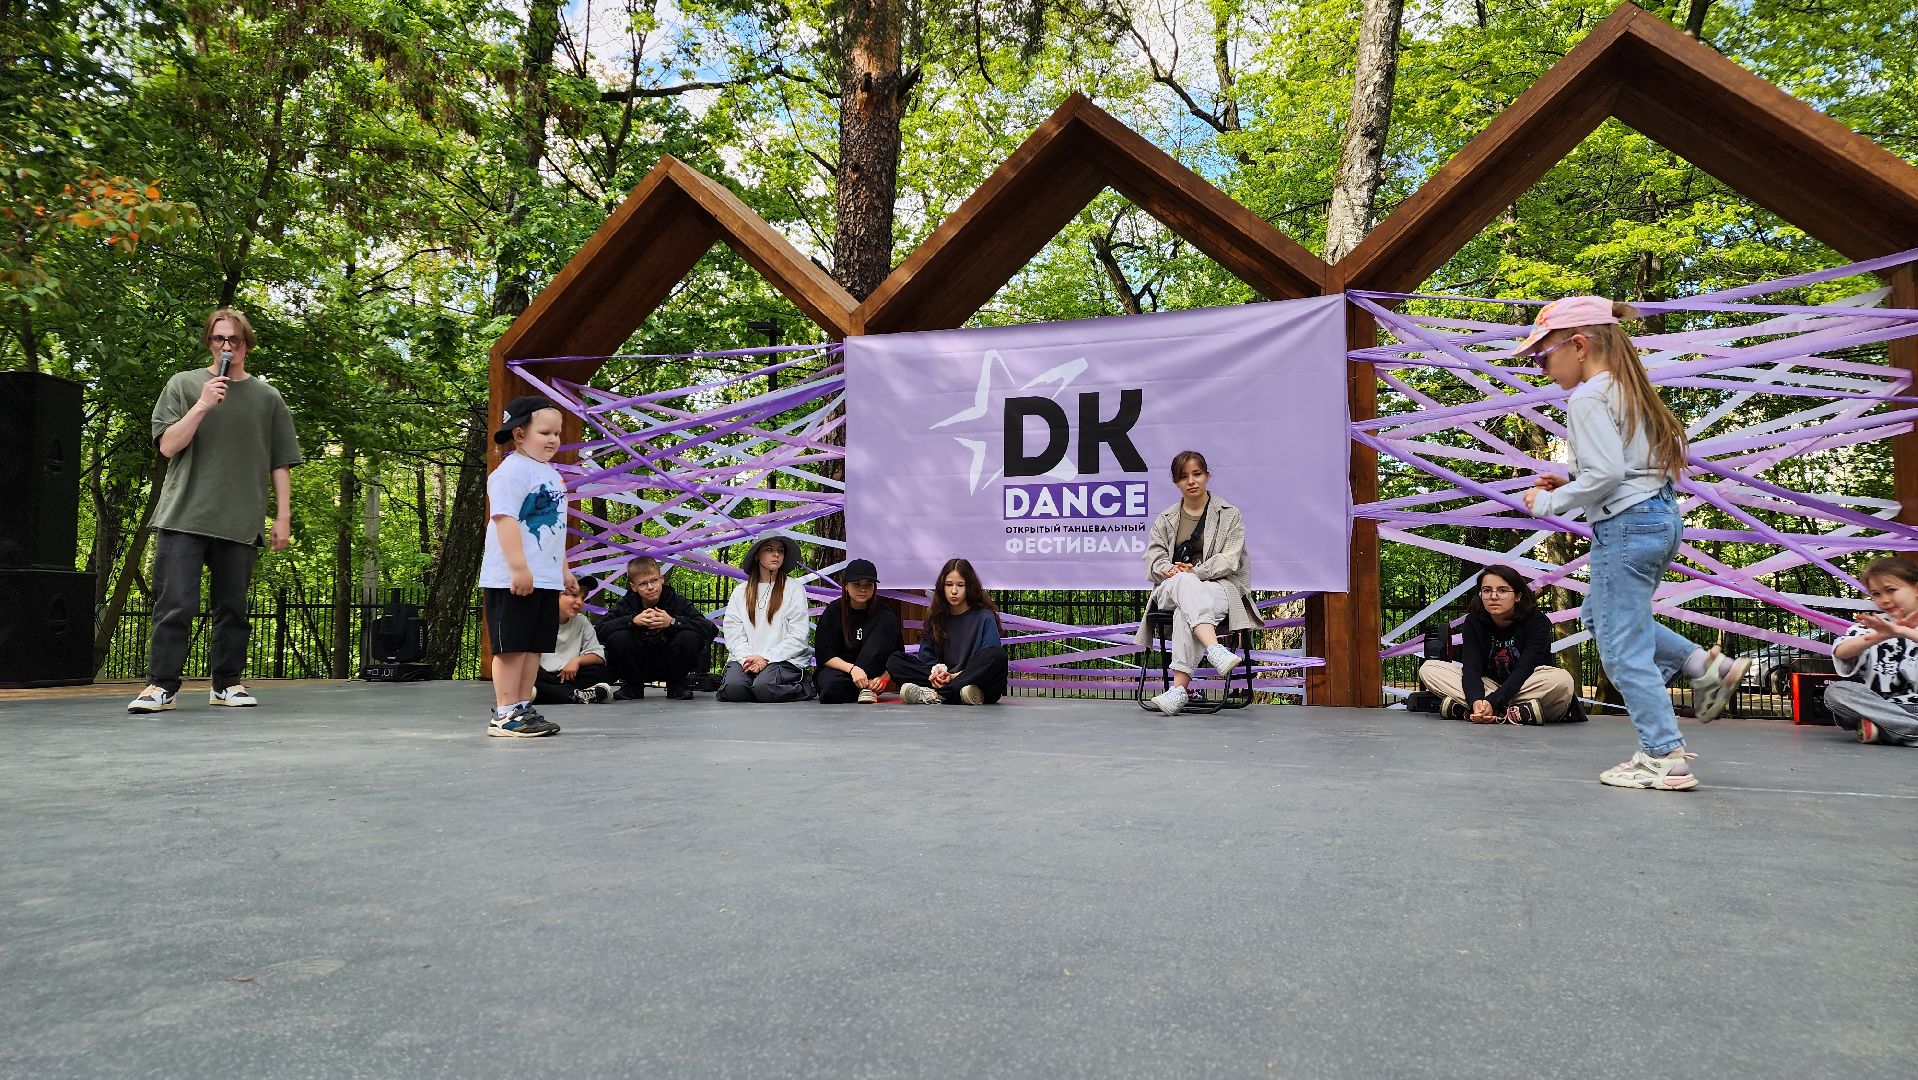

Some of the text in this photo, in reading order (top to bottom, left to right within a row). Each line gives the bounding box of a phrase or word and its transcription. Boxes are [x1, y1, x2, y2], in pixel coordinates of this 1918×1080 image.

[1004, 389, 1148, 477] DK
[1005, 484, 1145, 517] DANCE
[1005, 522, 1146, 534] ОТКРЫТЫЙ ТАНЦЕВАЛЬНЫЙ
[1005, 535, 1146, 554] ФЕСТИВАЛЬ
